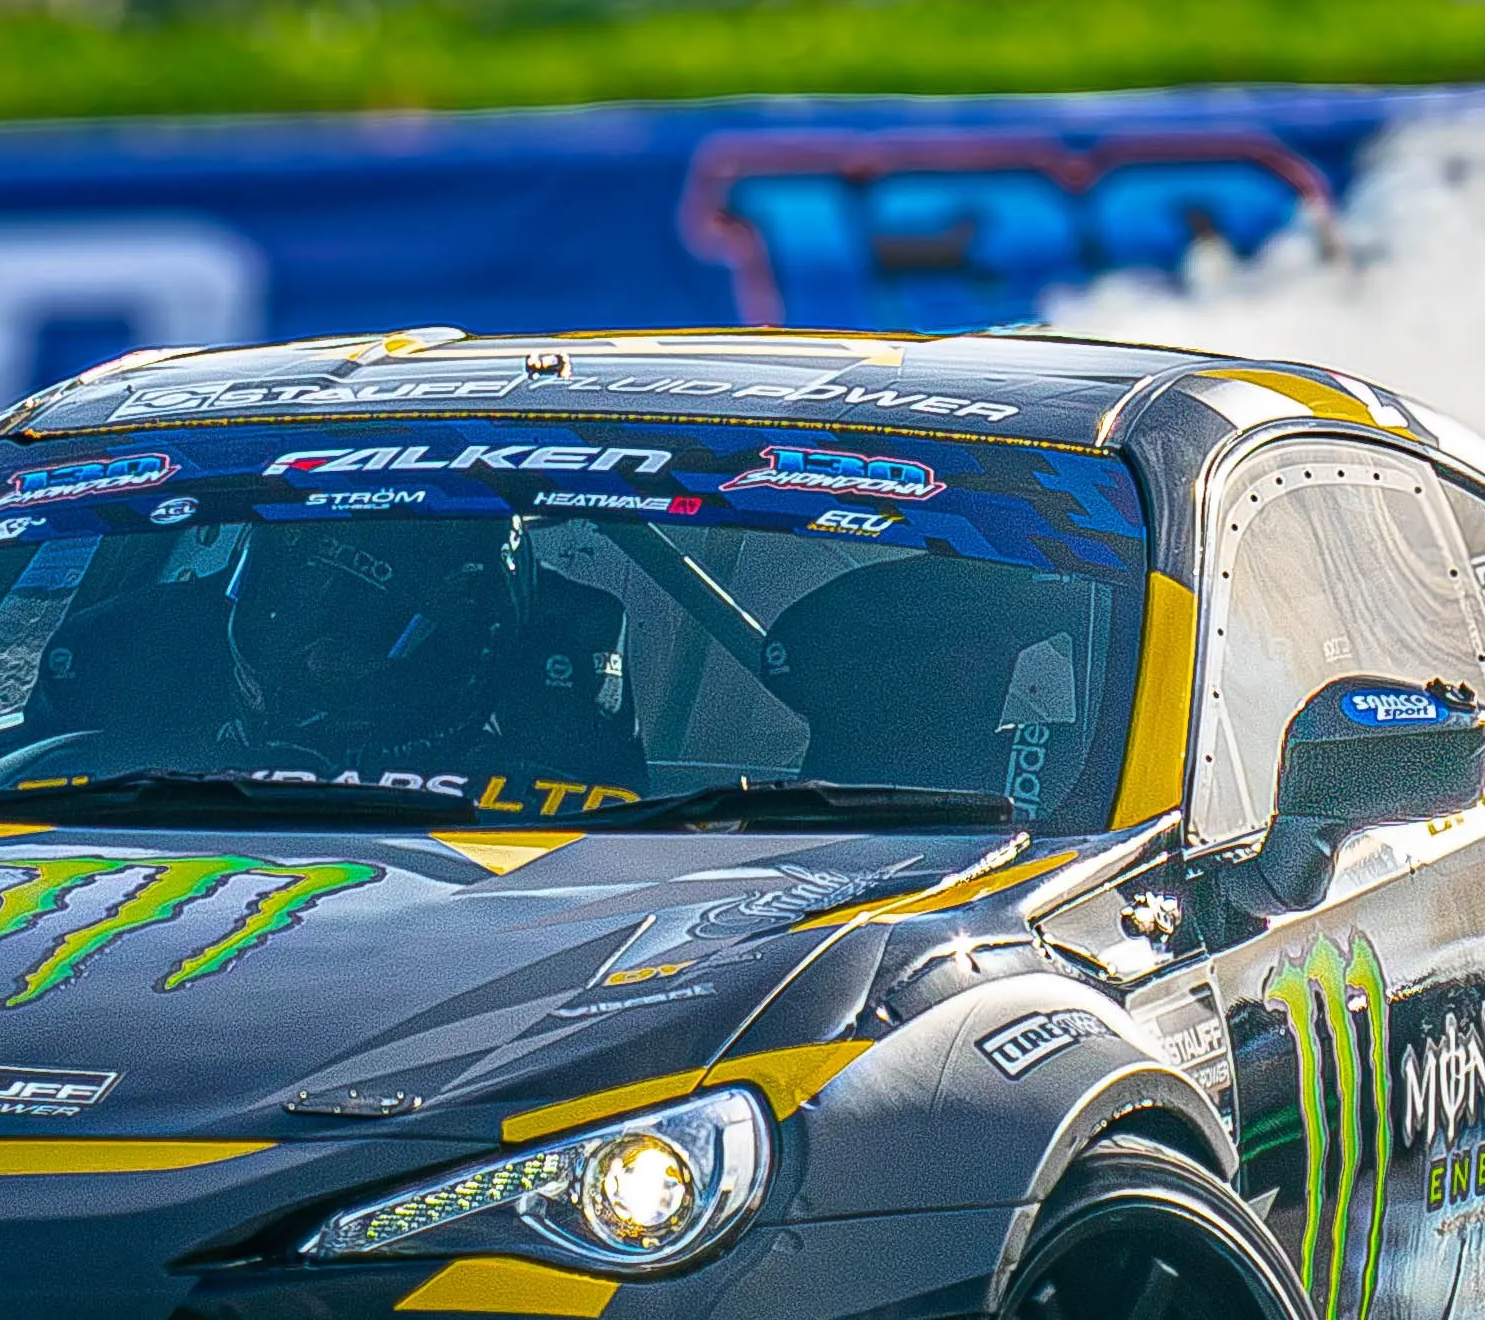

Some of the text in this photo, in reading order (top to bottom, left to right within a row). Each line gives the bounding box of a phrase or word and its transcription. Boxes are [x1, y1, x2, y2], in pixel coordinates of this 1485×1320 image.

[213, 374, 1021, 422] STAUFF FLUID POWER
[261, 444, 674, 476] FALKEN
[738, 469, 936, 496] SHOWDOWN
[306, 487, 426, 506] STRÖM
[533, 490, 672, 511] HEATWAVE
[815, 509, 896, 531] ECU
[1353, 693, 1429, 711] SAMCO
[1384, 704, 1431, 720] sport
[477, 775, 643, 815] LTD
